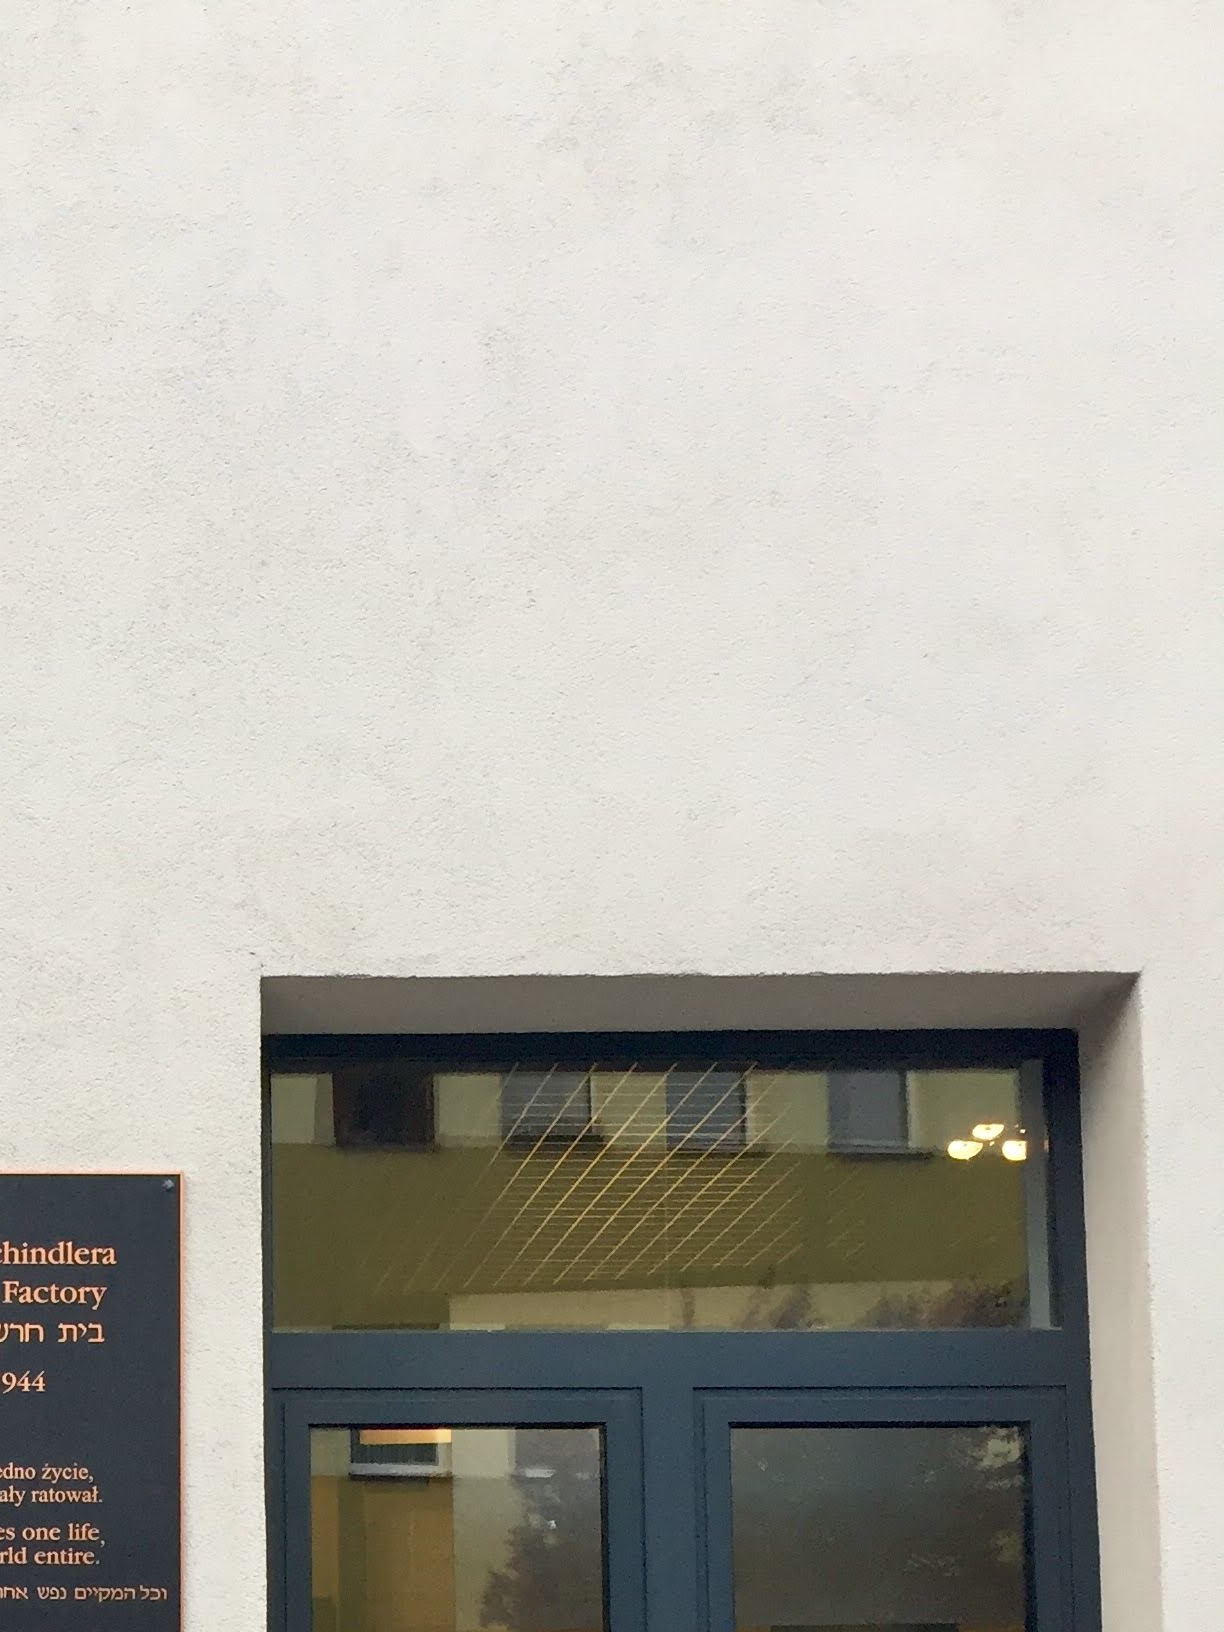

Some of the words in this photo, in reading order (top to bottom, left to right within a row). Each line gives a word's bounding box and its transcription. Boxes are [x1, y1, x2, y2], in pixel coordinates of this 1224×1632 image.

[2, 1281, 107, 1309] Factory
[58, 1323, 105, 1342] בית
[42, 1463, 93, 1484] życie,
[31, 1486, 102, 1502] ratował.
[22, 1528, 61, 1540] one
[68, 1523, 105, 1547] life,
[34, 1548, 99, 1564] entire.
[37, 1587, 67, 1599] נפש
